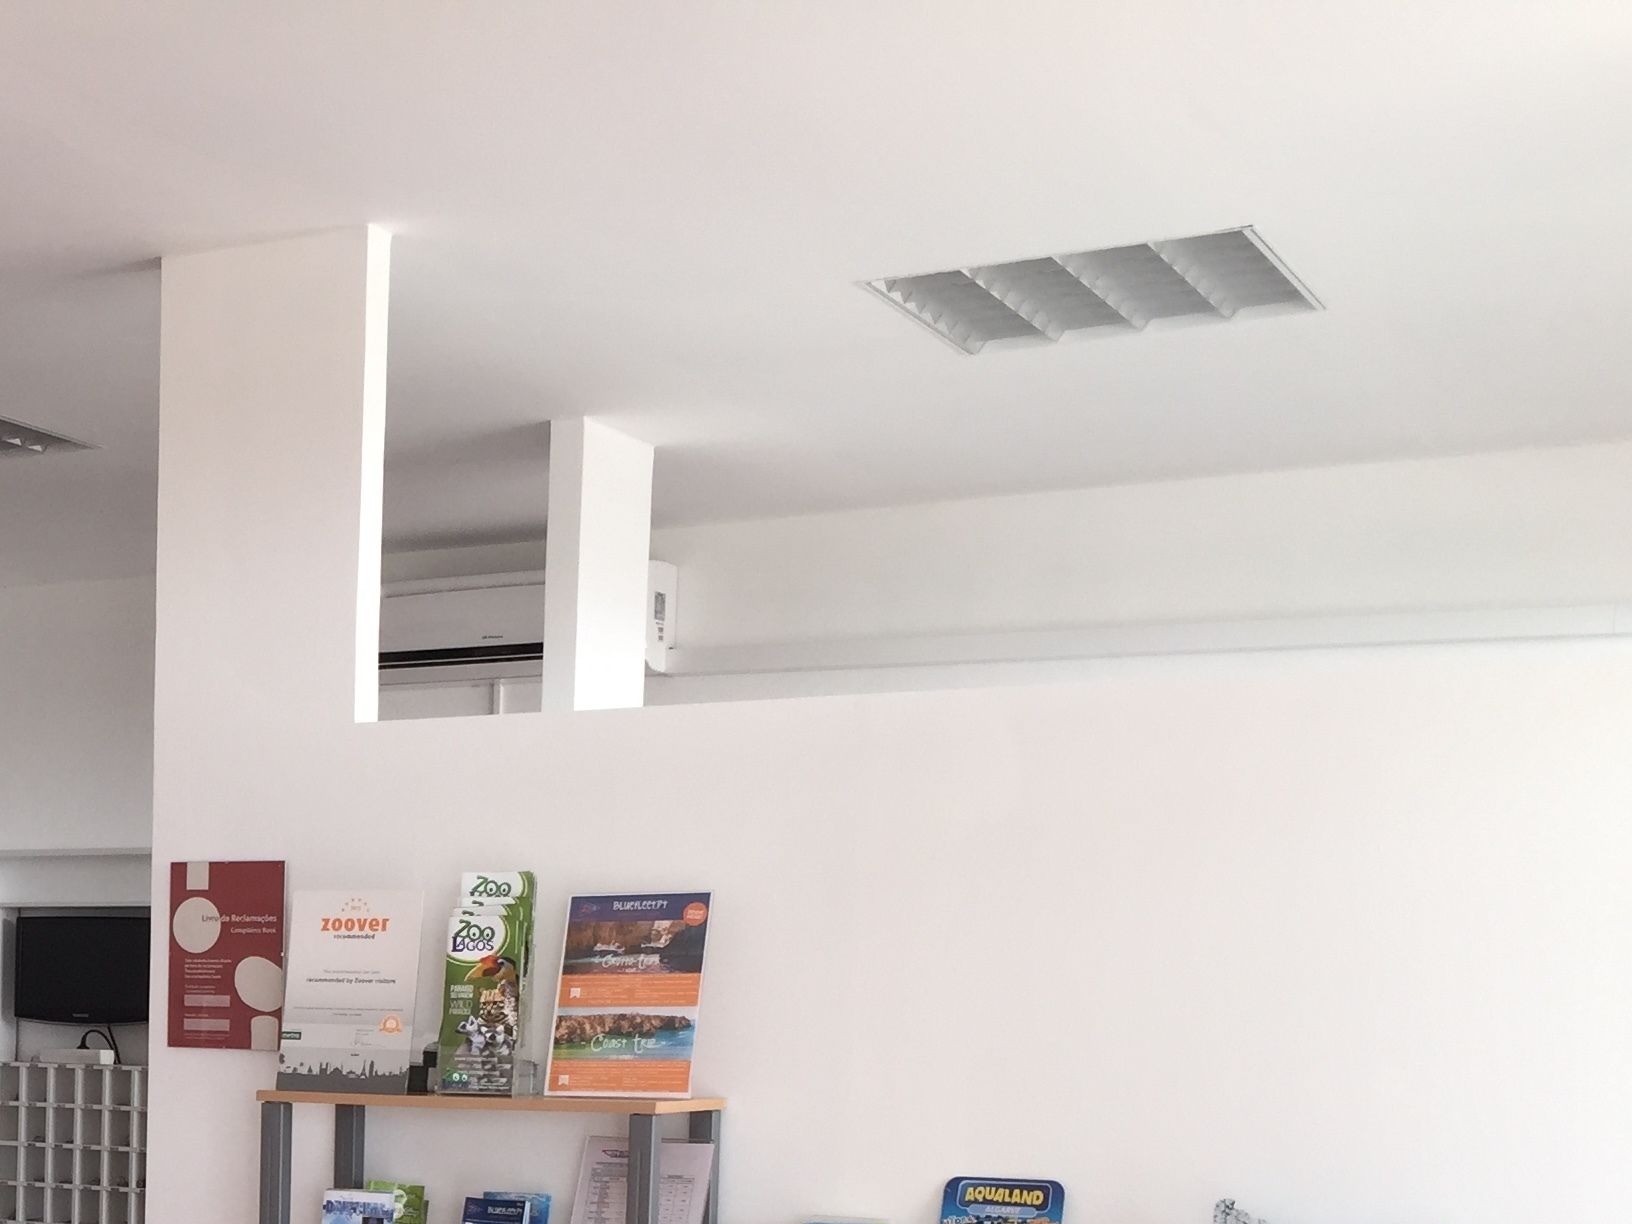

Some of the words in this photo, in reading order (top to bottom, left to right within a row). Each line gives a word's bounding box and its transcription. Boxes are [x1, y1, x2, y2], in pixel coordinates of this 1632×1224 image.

[320, 917, 390, 932] zoover
[453, 918, 496, 941] Zoo
[451, 936, 495, 953] LAGOS
[963, 1186, 1044, 1206] AQUALAND
